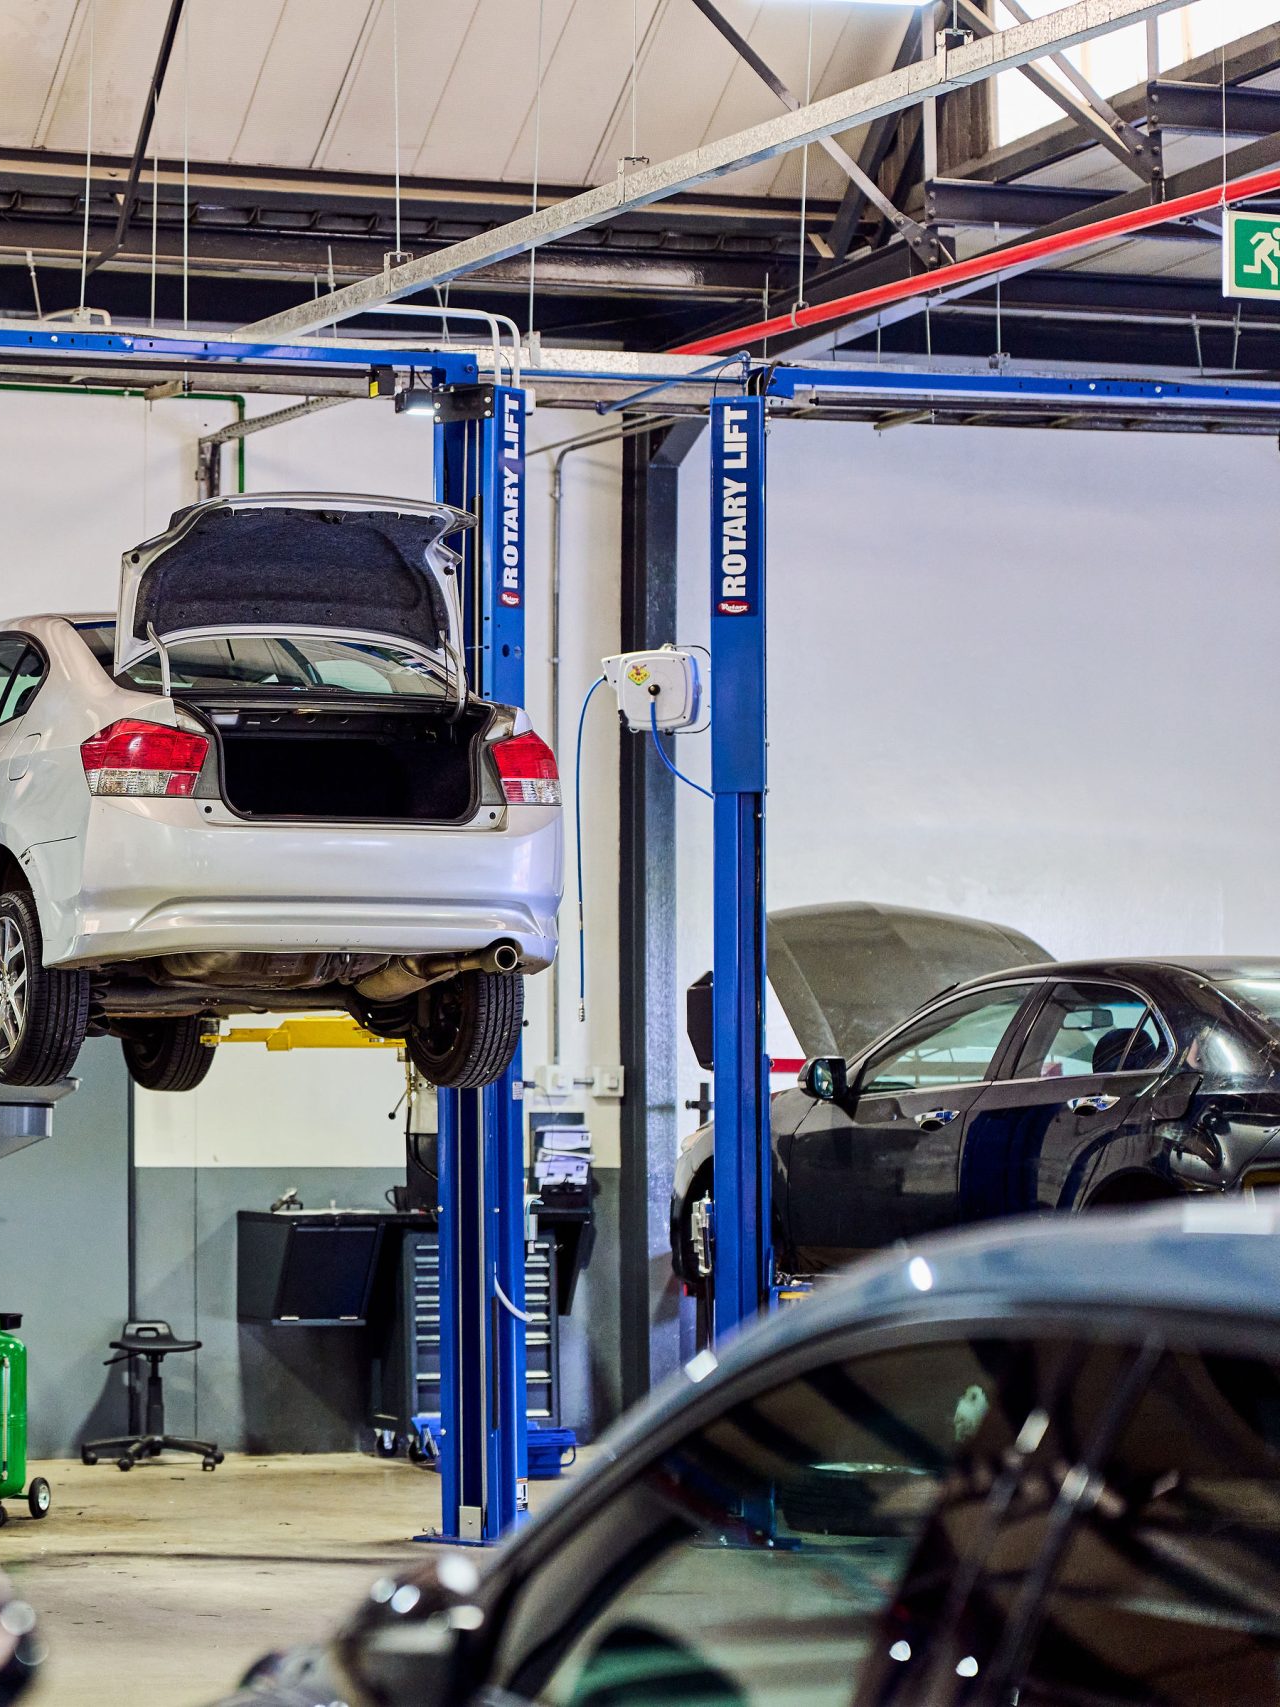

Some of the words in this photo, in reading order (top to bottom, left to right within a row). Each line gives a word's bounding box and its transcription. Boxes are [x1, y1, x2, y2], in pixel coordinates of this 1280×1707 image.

[504, 394, 519, 460] LIFT
[723, 406, 748, 469] LIFT
[503, 466, 519, 589] ROTARY
[722, 477, 747, 597] ROTARY
[720, 603, 748, 613] Rotary
